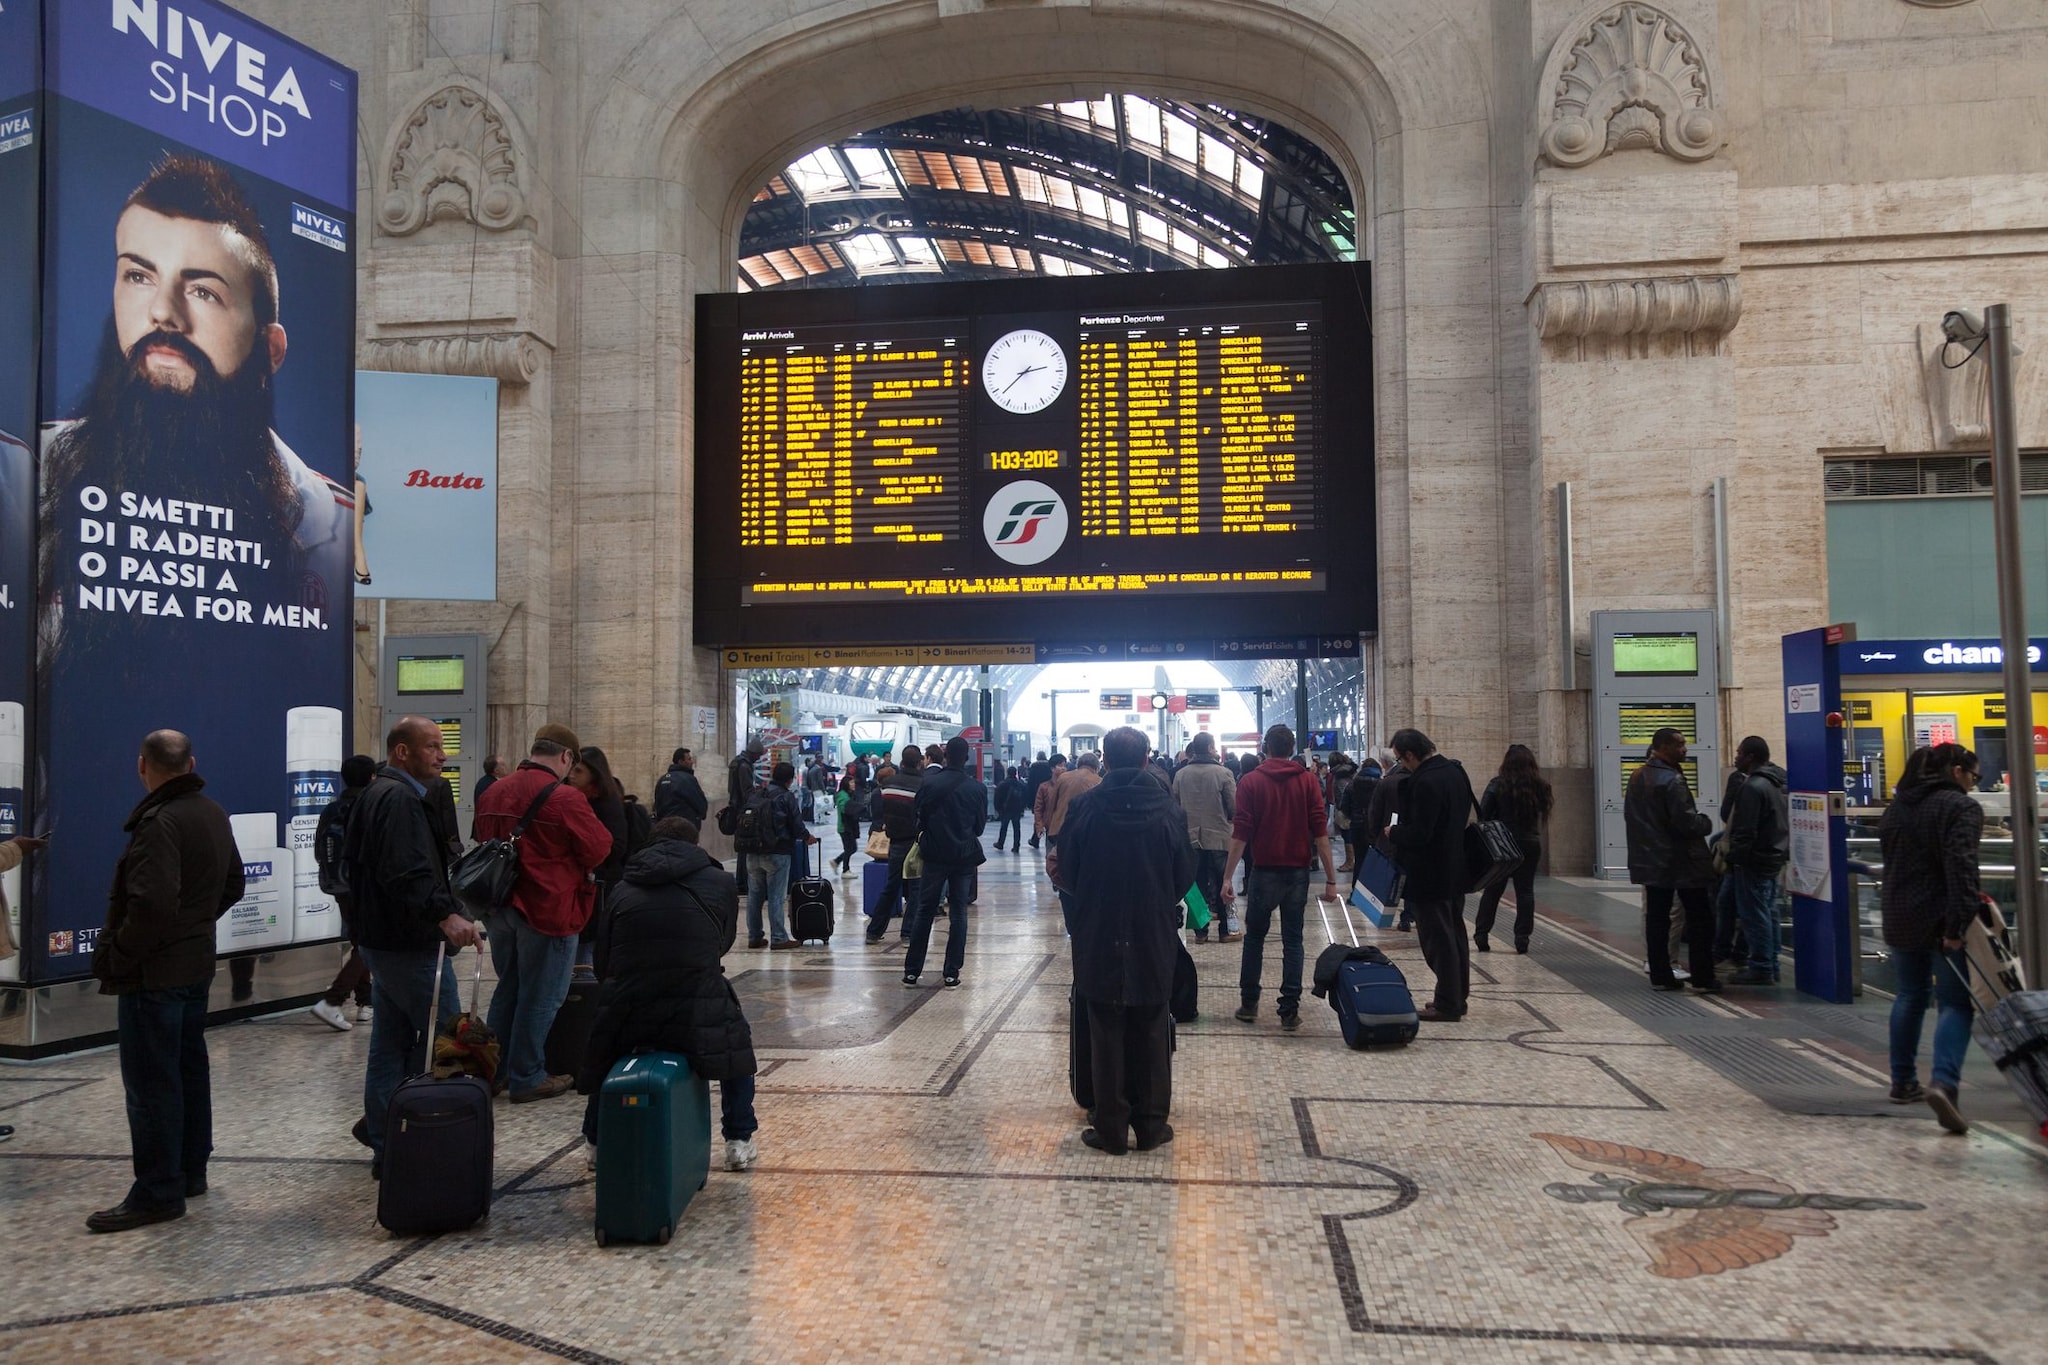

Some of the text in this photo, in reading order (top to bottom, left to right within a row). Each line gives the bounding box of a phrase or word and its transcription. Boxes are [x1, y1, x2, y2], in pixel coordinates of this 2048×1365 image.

[112, 0, 312, 119] NIVEA
[150, 61, 287, 146] SHOP
[297, 209, 343, 238] NIVEA
[1080, 315, 1165, 325] Partenze Departures
[742, 331, 794, 340] Arrivi Arrivals
[1220, 337, 1261, 345] CANCELLATO
[1220, 346, 1262, 355] CANCELLATO
[1220, 356, 1262, 365] CANCELLATO
[873, 390, 912, 399] CANCELLATO
[1221, 396, 1262, 404] CANCELLATO
[1221, 406, 1262, 414] CANCELLATO
[900, 418, 924, 426] CLASSE
[873, 438, 912, 446] CANCELLATO
[1221, 445, 1263, 453] CANCELLATO
[873, 458, 912, 466] CANCELLATO
[991, 450, 1058, 470] 1-03-2012
[404, 469, 485, 489] Bata
[902, 476, 926, 484] CLASSE
[908, 486, 932, 494] CLASSE
[1222, 485, 1263, 493] CANCELLATO
[873, 496, 913, 504] CANCELLATO
[1222, 495, 1263, 503] CANCELLATO
[80, 485, 233, 531] O SMETTI
[874, 525, 913, 533] CANCELLATO
[80, 518, 271, 569] DI RADERTI,
[79, 551, 238, 592] O PASSI A
[753, 584, 786, 592] ATTENTION
[1145, 574, 1166, 582] COULD
[1168, 574, 1178, 582] BE
[1181, 573, 1218, 581] CANCELLED
[1245, 572, 1278, 580] REROUTED
[1282, 571, 1311, 579] BECAUSE
[925, 586, 947, 594] STRIKE
[79, 584, 329, 630] NIVEA FOR MEN.
[1242, 642, 1272, 650] Servizi
[835, 649, 914, 658] Binari Platforms 1-13
[944, 646, 1031, 656] Binari Platforms 14-22
[1923, 643, 2041, 664] chane
[742, 651, 805, 662] Treni Trains
[294, 783, 334, 794] NIVEA
[232, 906, 259, 914] BALSAMO
[79, 942, 94, 953] EL
